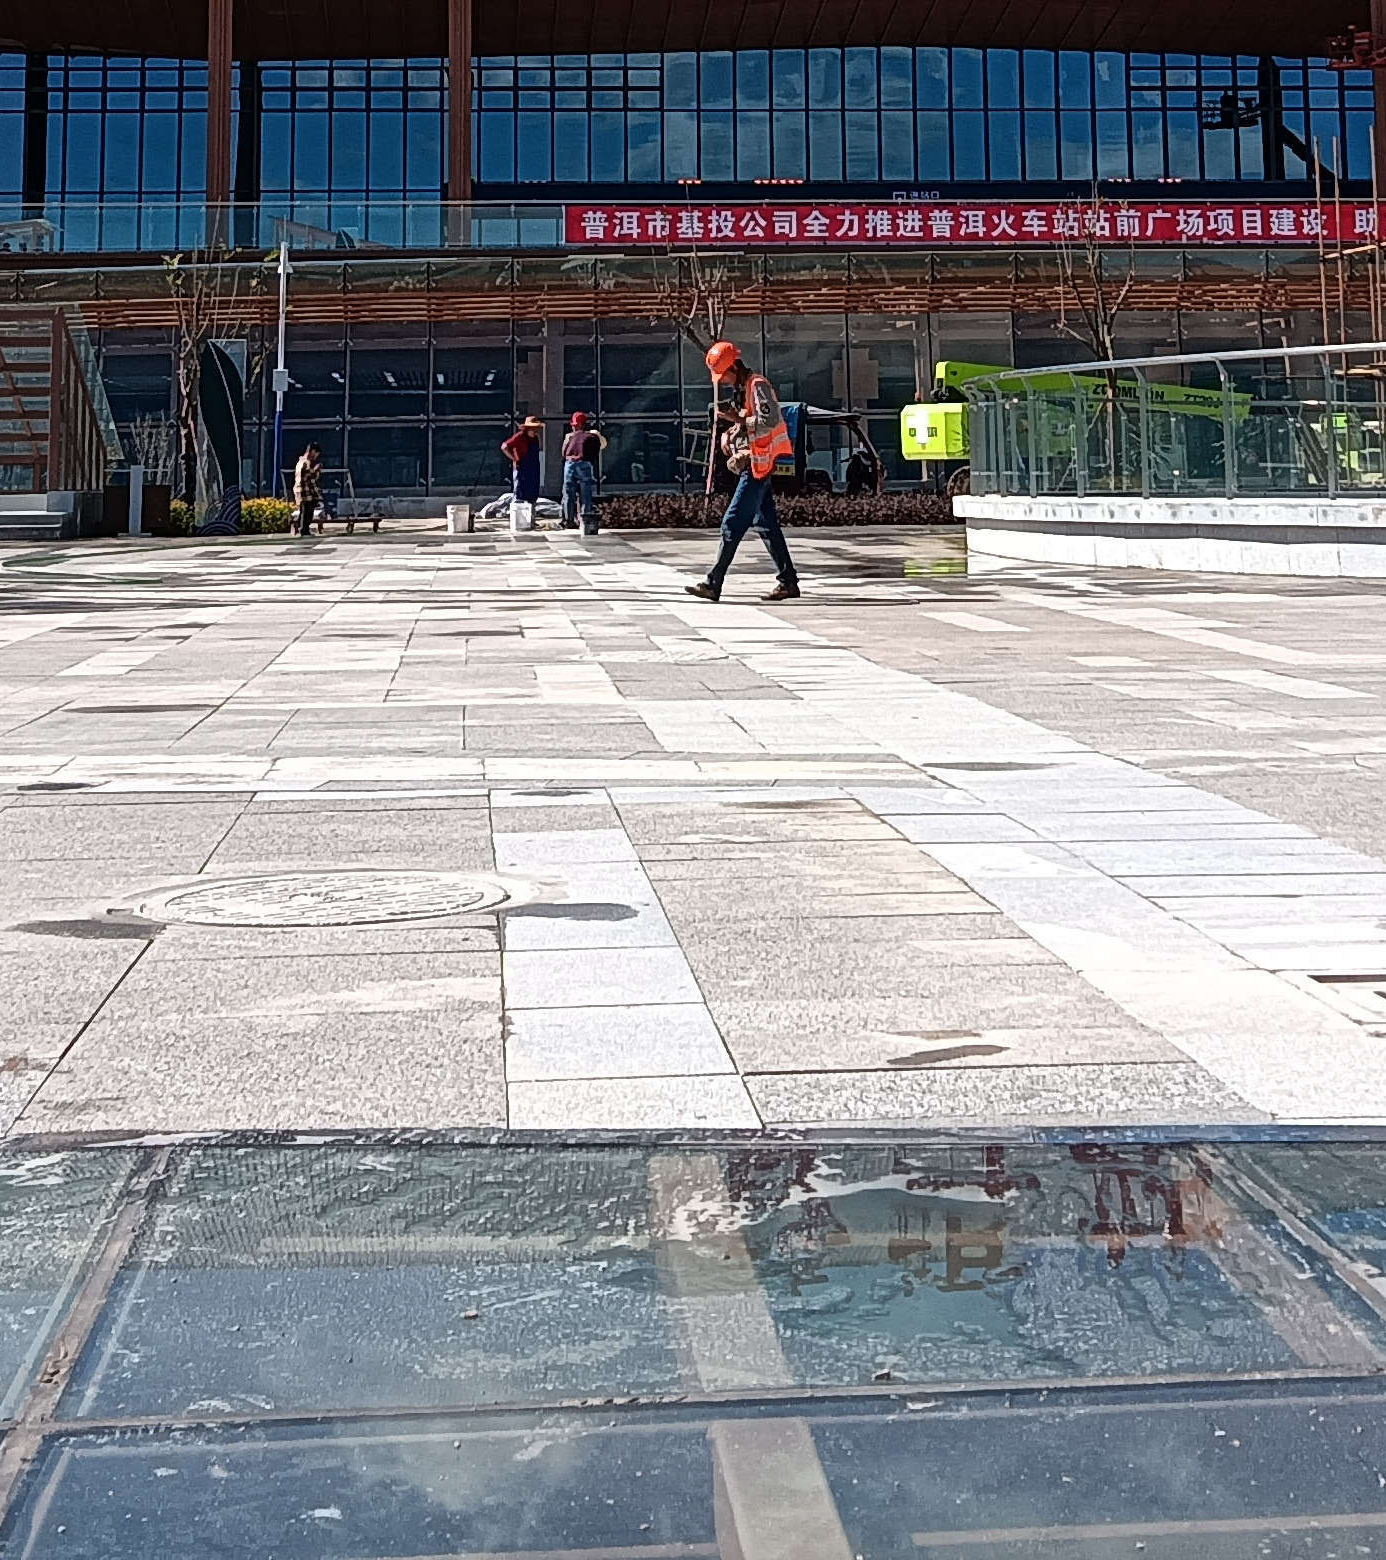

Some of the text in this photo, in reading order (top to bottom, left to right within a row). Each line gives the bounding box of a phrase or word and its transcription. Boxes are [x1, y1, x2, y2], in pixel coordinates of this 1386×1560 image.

[581, 208, 1327, 237] 普洱市基投公司全力推进普洱火车站站前广场项目建设
